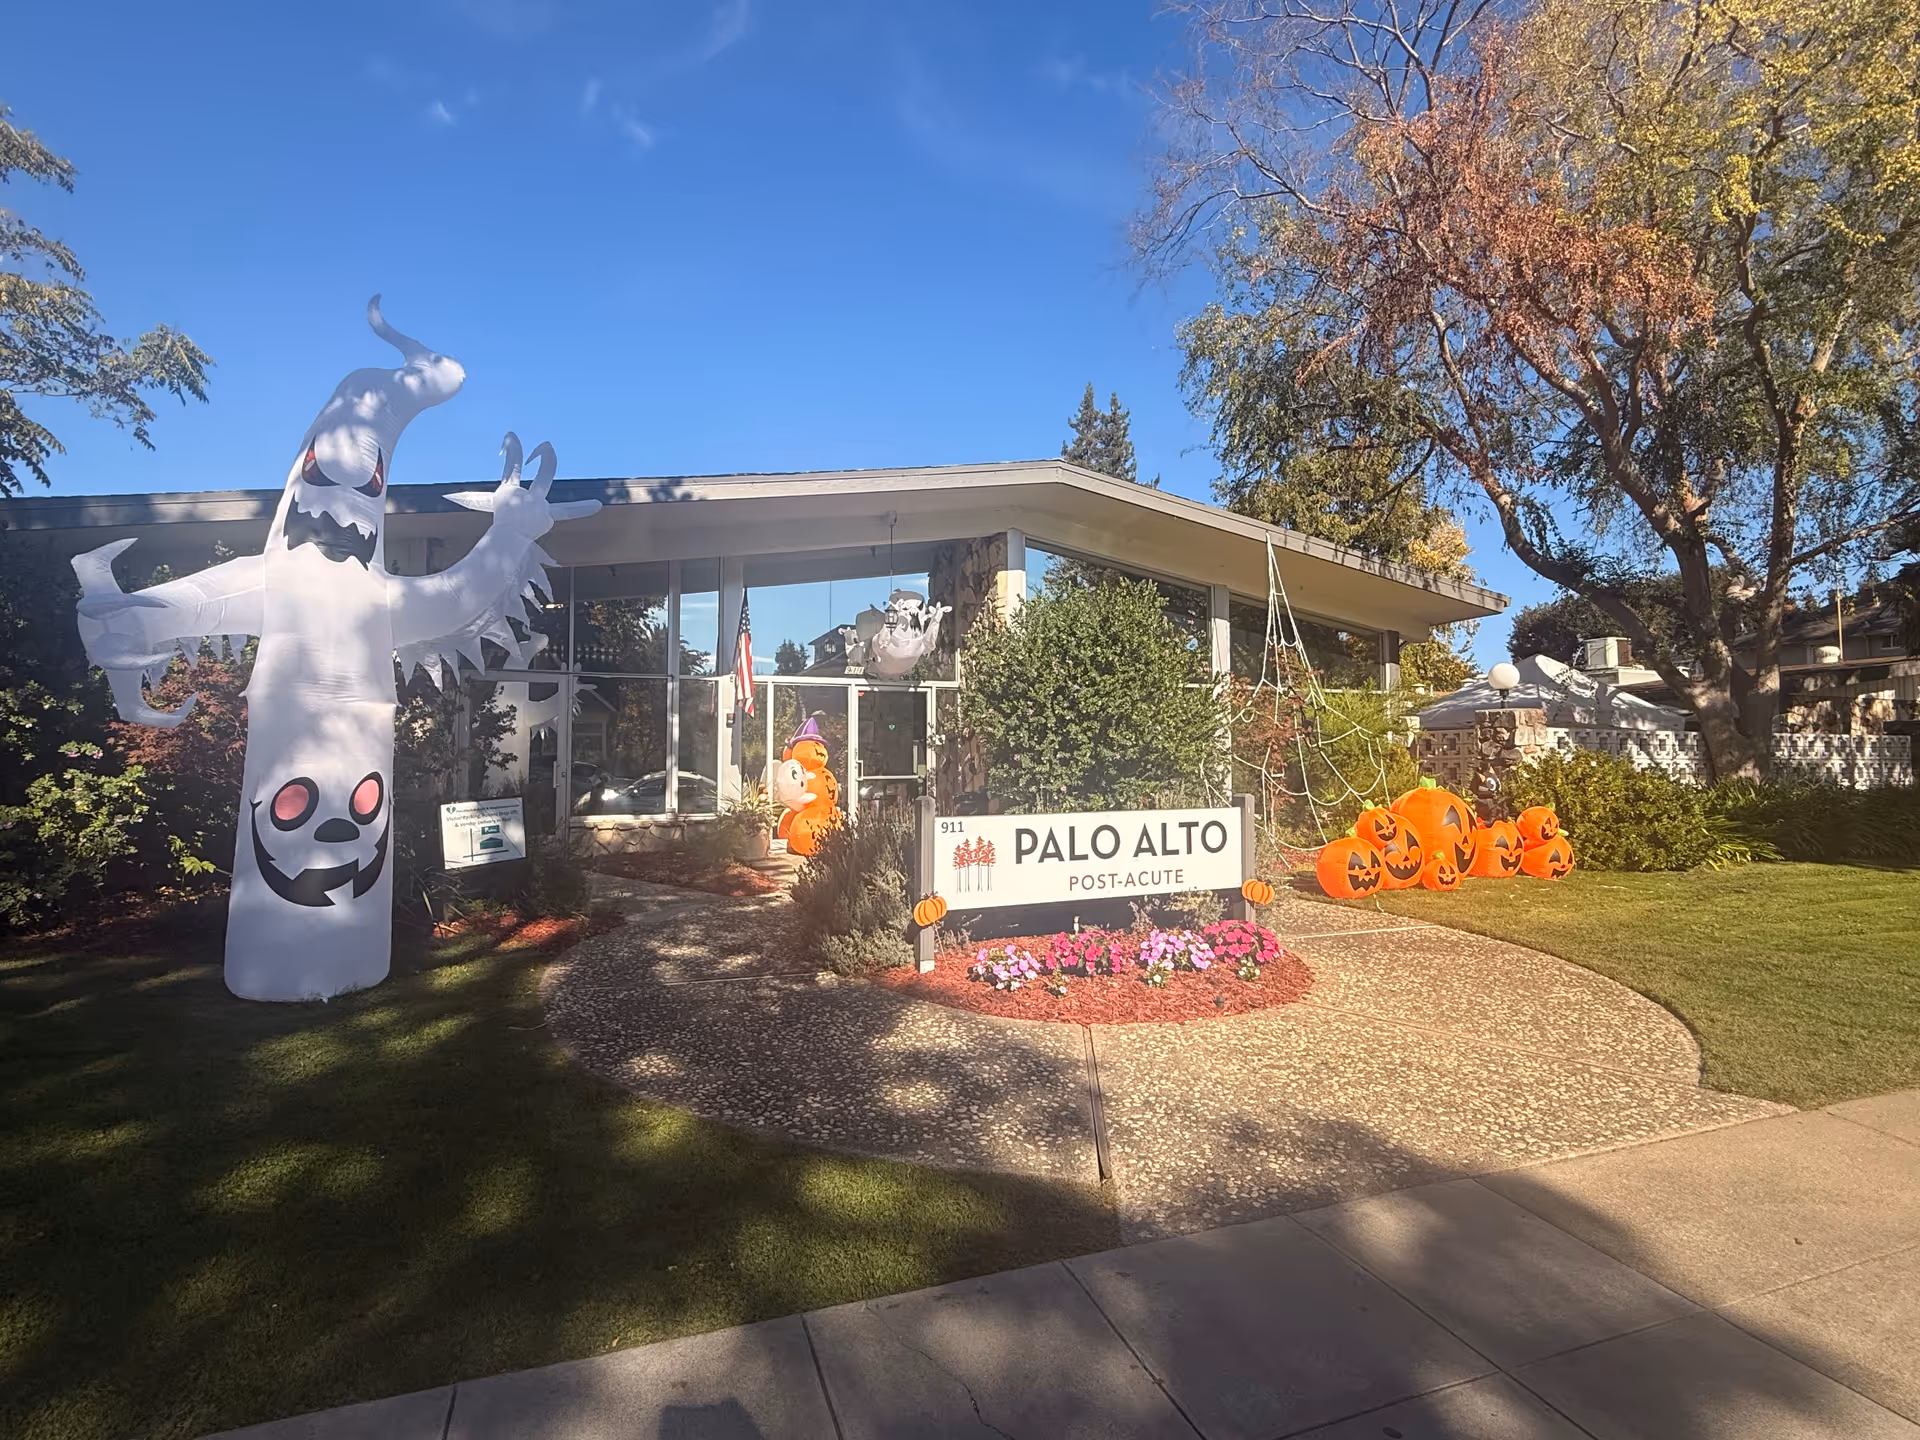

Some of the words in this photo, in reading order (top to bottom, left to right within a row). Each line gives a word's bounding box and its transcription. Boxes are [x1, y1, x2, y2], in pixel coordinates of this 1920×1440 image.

[941, 821, 965, 834] 911
[1015, 824, 1121, 865] PALO
[1132, 820, 1228, 858] ALTO
[1069, 869, 1184, 891] POST-ACUTE
